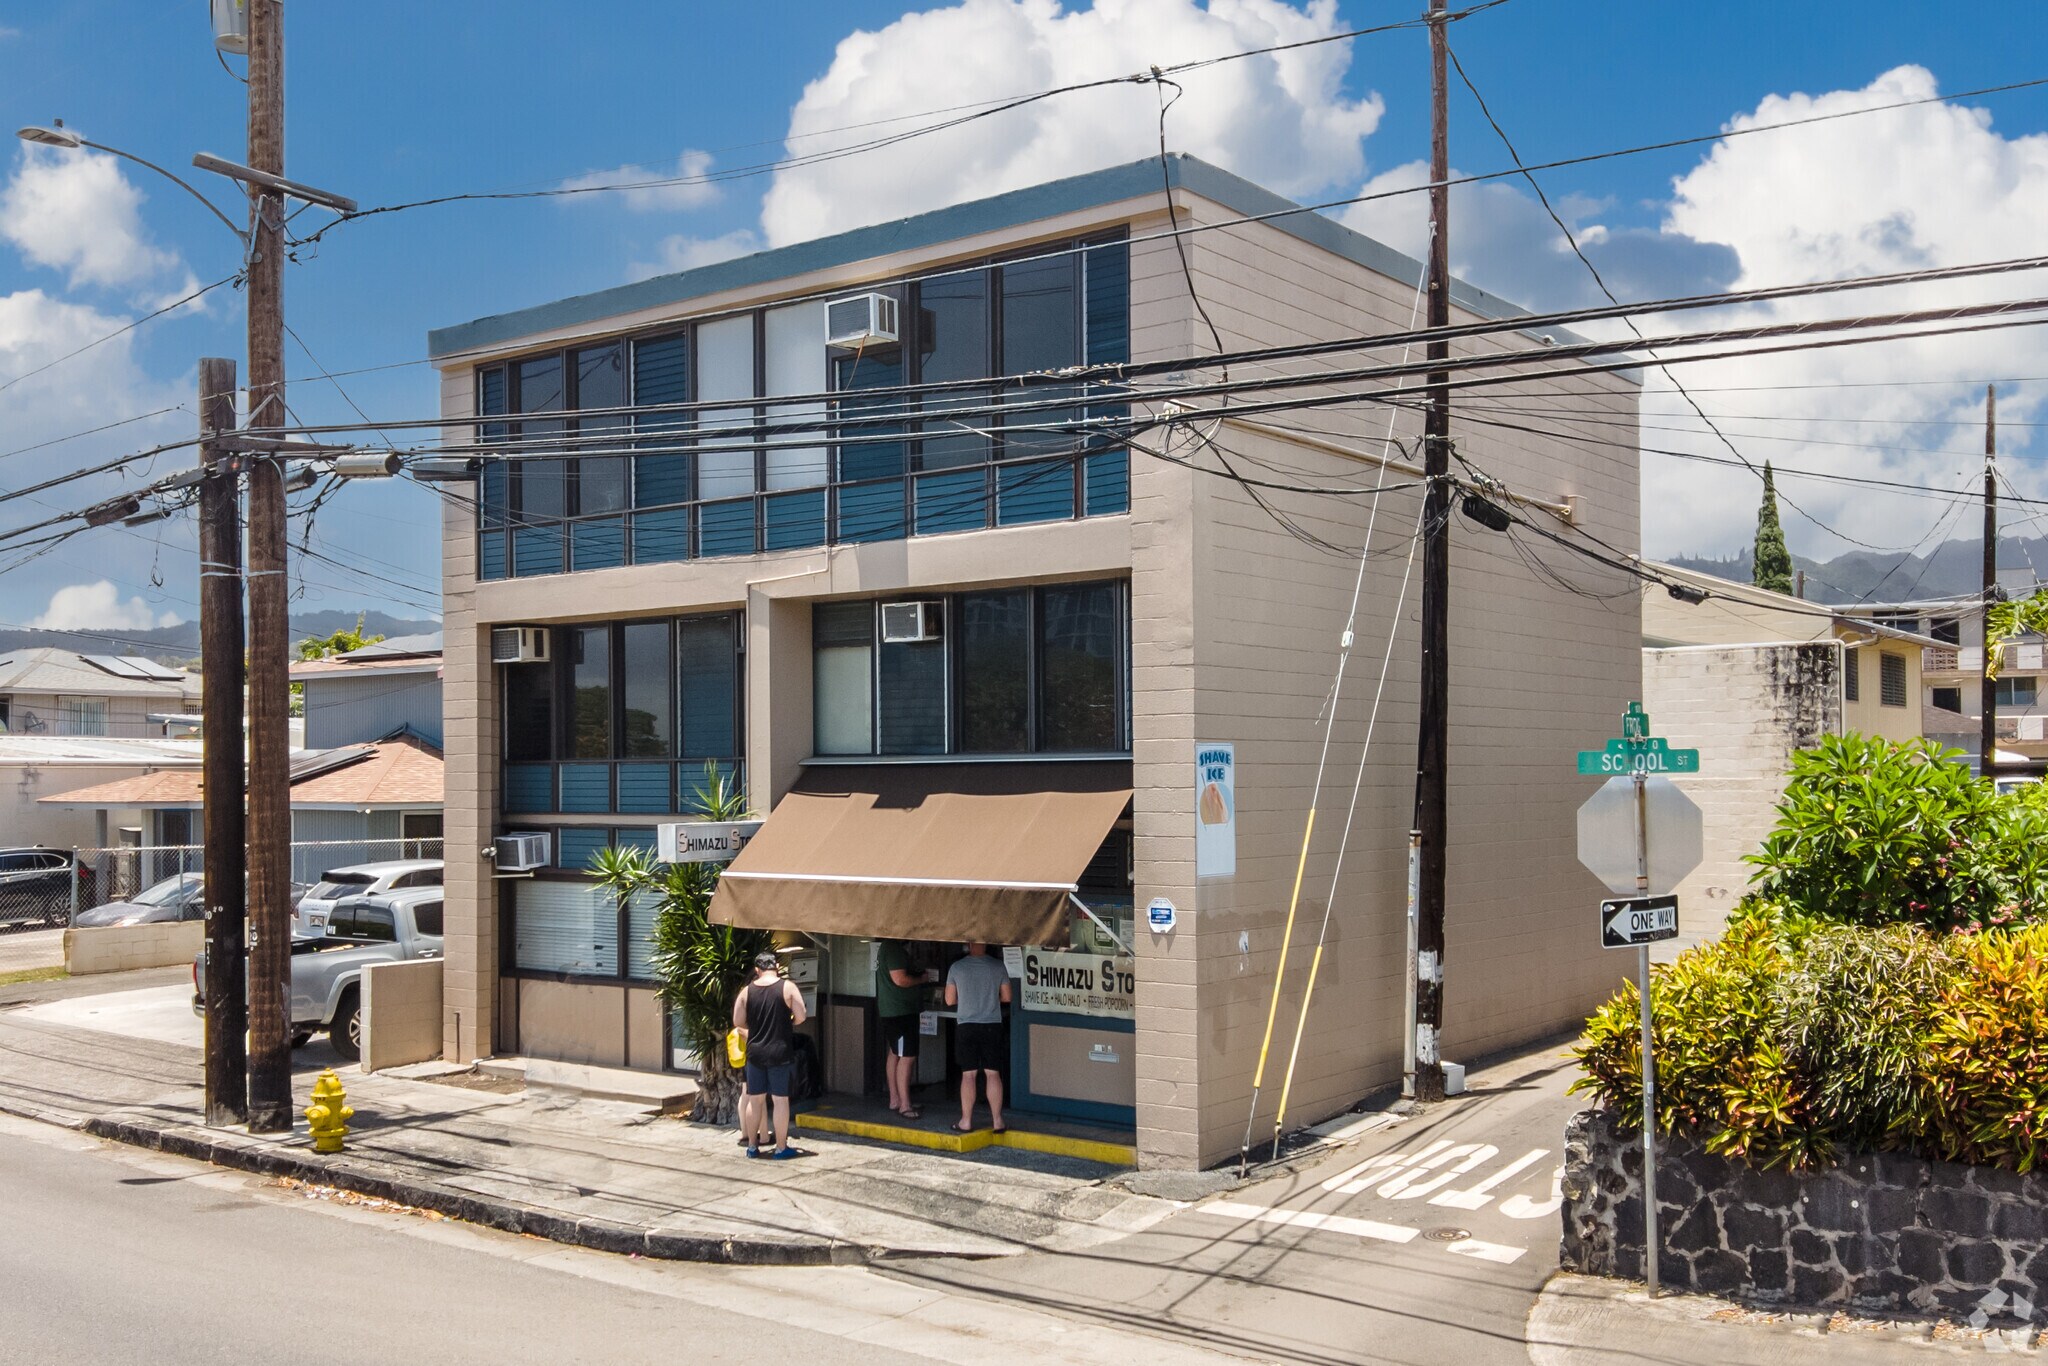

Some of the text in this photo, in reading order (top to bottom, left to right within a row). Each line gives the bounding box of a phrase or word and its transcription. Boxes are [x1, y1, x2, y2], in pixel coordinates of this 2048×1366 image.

[1199, 750, 1231, 766] SHAVE
[1601, 752, 1688, 772] SCOOL ST
[1206, 766, 1225, 781] ICE
[679, 829, 728, 853] SHIMAZU
[1631, 908, 1673, 931] ONE WAY
[1026, 955, 1094, 991] SHIMAZU
